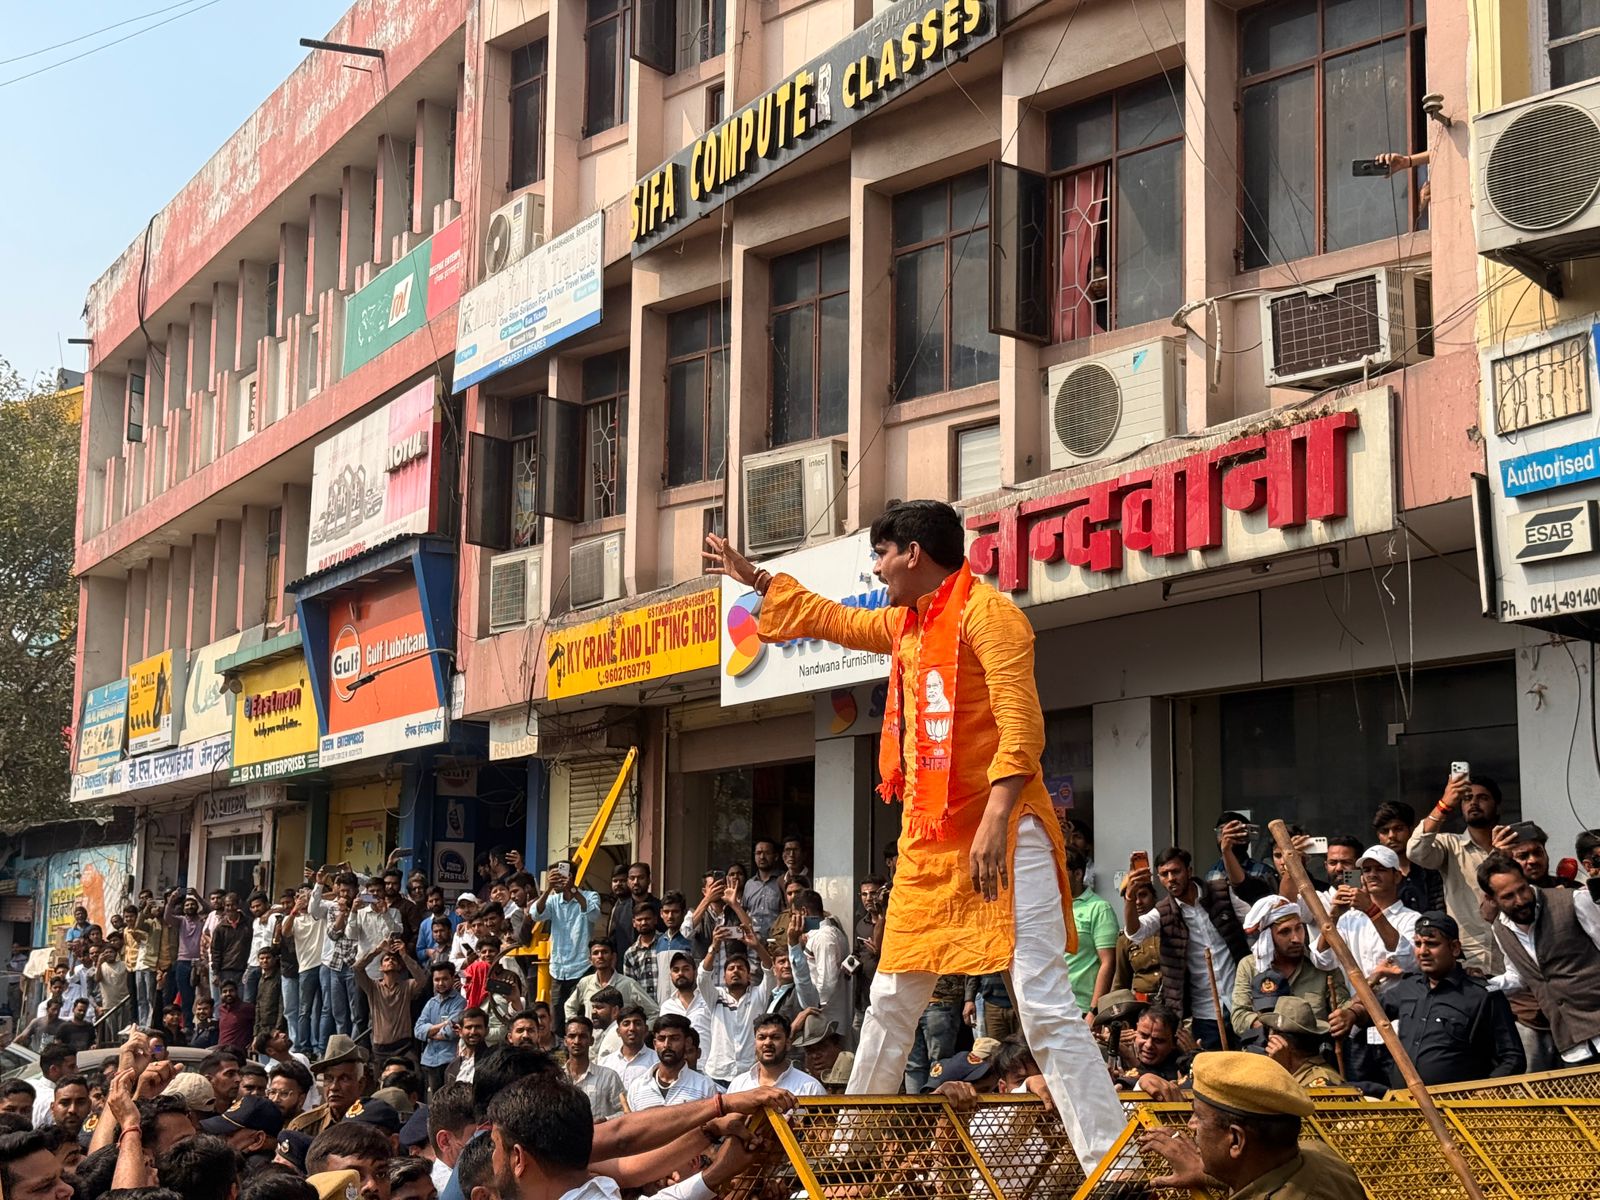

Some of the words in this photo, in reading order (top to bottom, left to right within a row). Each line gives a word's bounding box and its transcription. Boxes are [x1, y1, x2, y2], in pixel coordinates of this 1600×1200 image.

[630, 163, 678, 242] SIFA
[690, 63, 832, 201] COMPUTER
[842, 0, 982, 108] CLASSES
[565, 276, 580, 292] Travel
[1506, 453, 1595, 489] Authorised
[966, 411, 1358, 592] नन्दवाना
[1525, 522, 1573, 544] ESAB
[583, 633, 617, 671] CRANE
[619, 625, 641, 662] AND
[645, 612, 689, 656] LIFTING
[692, 604, 717, 644] HUB
[334, 651, 360, 676] Gulf
[366, 638, 384, 667] Gulf
[798, 661, 840, 678] Nandwana
[842, 652, 886, 670] Furnishing
[252, 687, 302, 719] Eastman
[264, 755, 306, 777] ENTERPRISES
